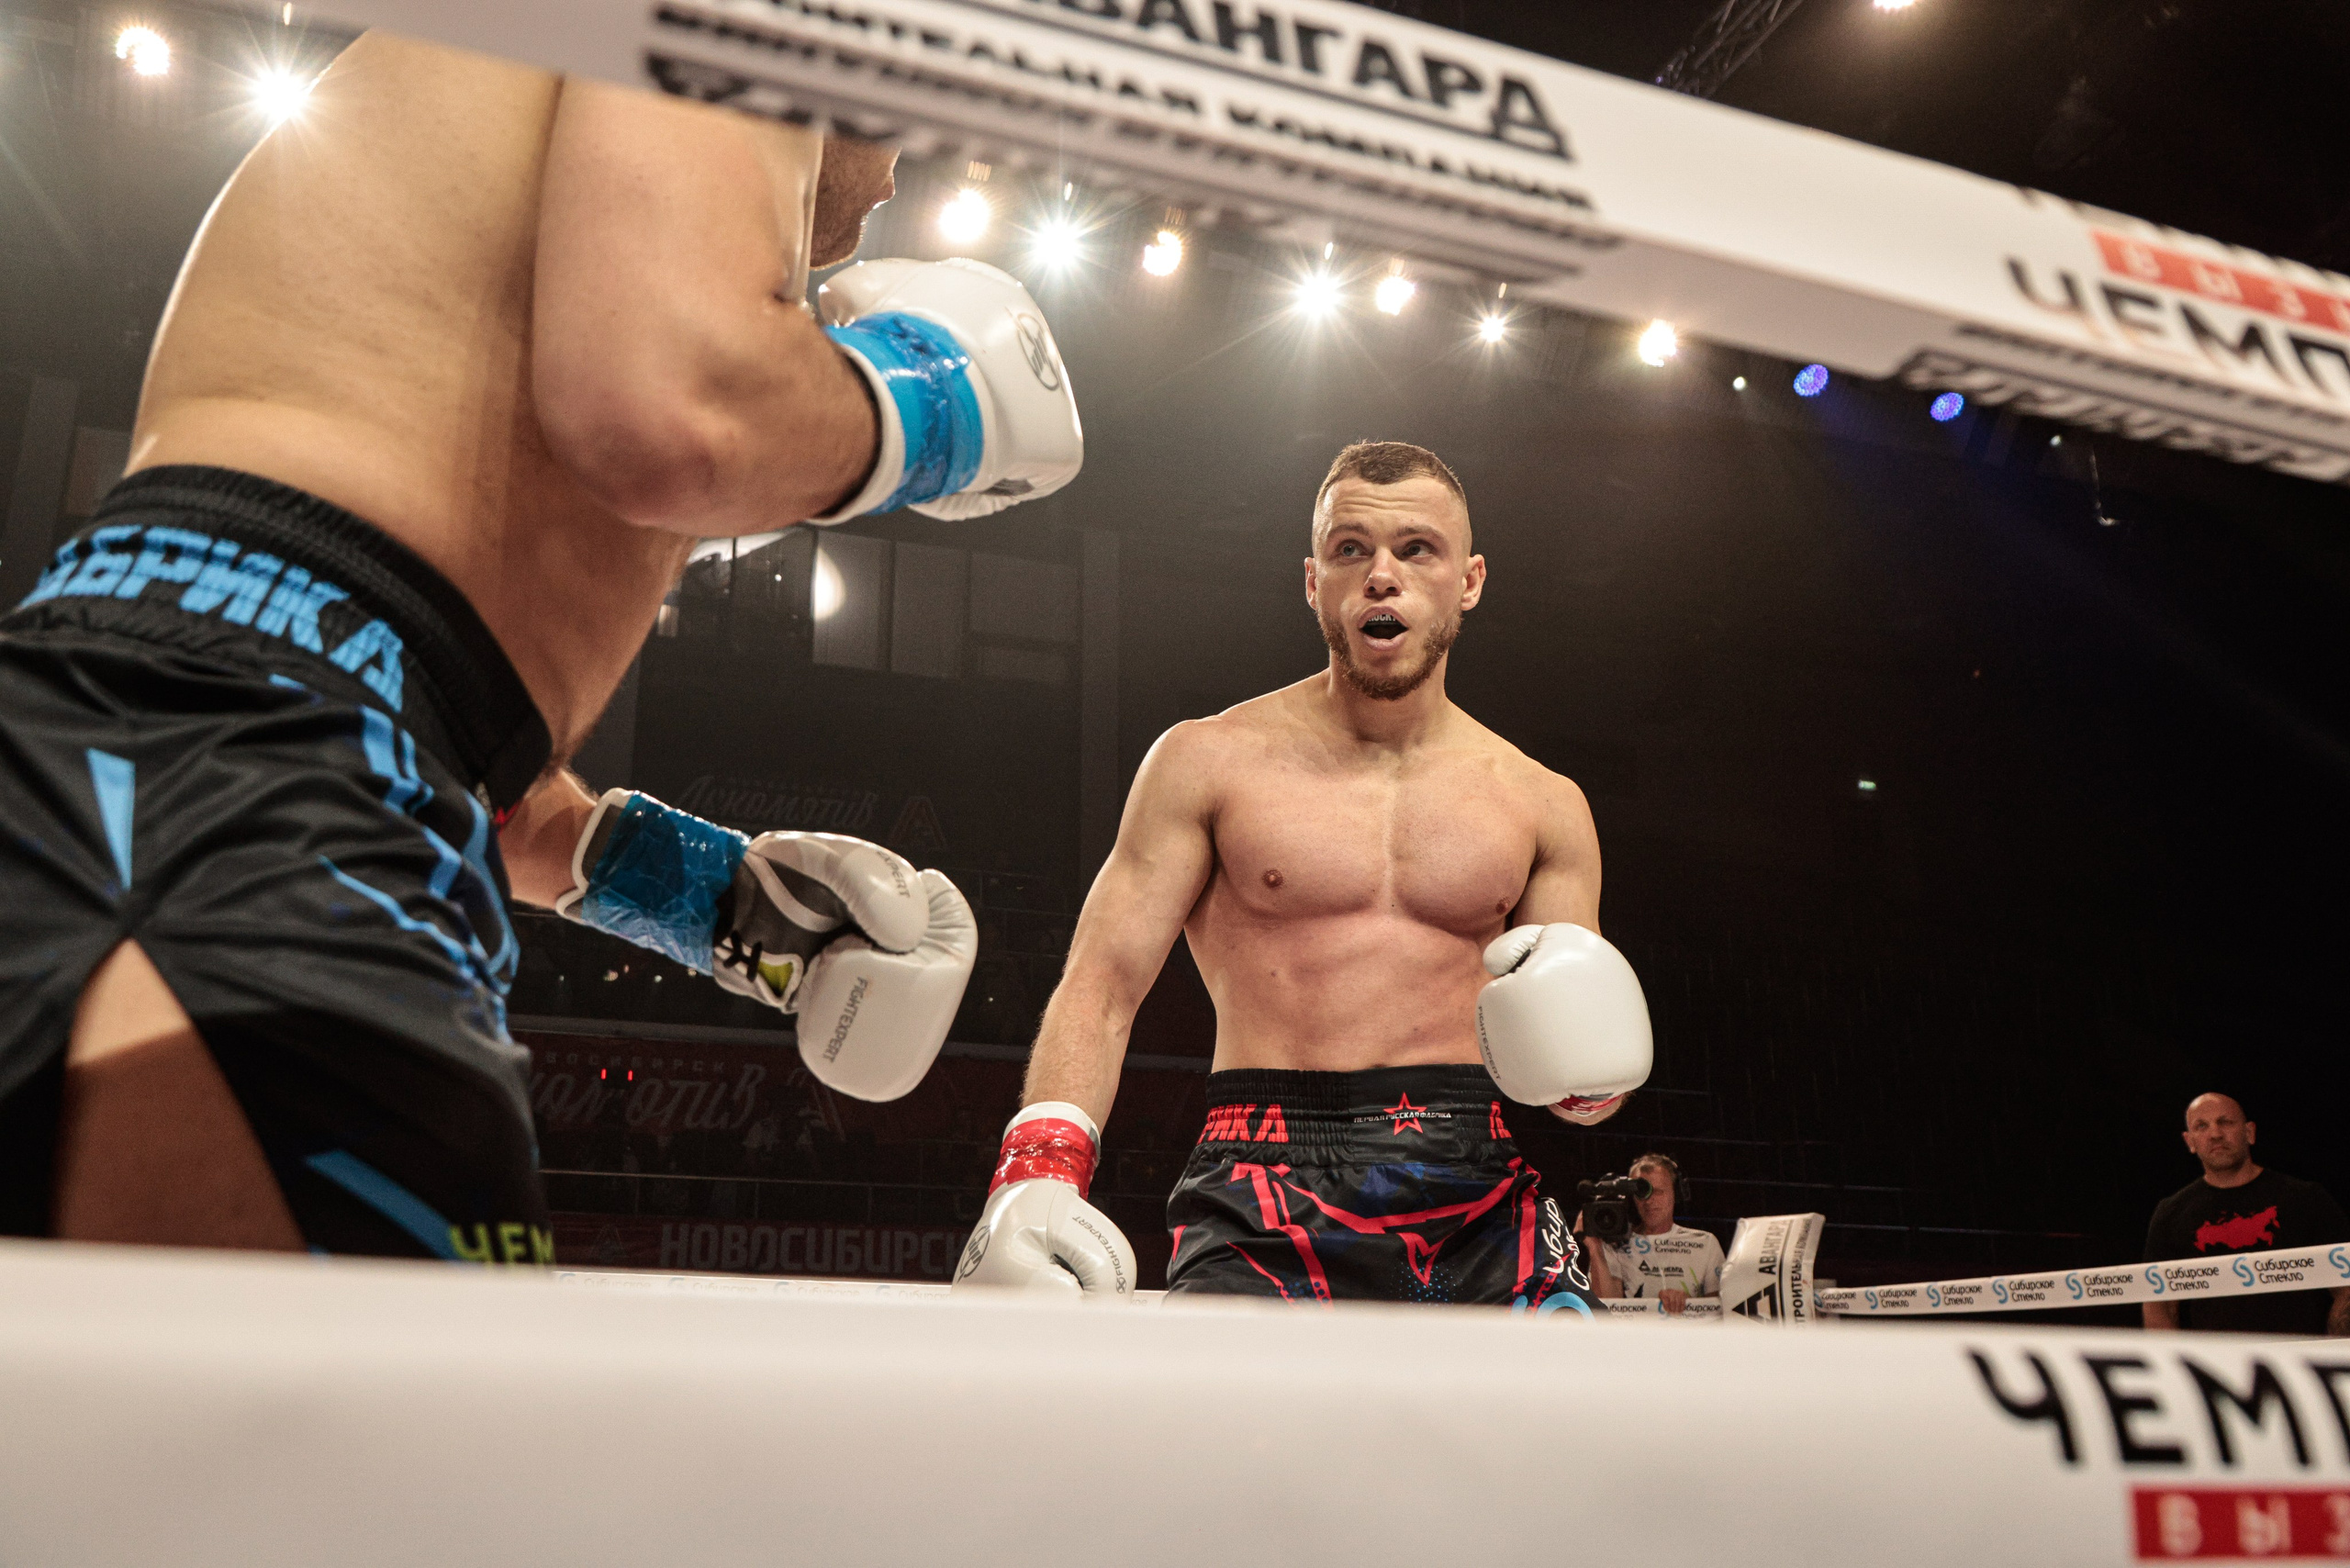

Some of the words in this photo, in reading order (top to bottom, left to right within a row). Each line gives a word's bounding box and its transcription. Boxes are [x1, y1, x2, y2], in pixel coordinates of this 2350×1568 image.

[822, 976, 868, 1063] FIGHTEXPERT
[1478, 1005, 1502, 1080] FIGHTEXPERT
[1072, 1215, 1124, 1276] FIGHTEXPERT
[2254, 1257, 2314, 1272] Сибирское
[2165, 1265, 2220, 1280] Сибирское
[2259, 1271, 2304, 1284] Стекло
[2084, 1273, 2133, 1285] Сибирское
[1942, 1284, 1983, 1295] Сибирское
[2009, 1280, 2055, 1292] Сибирское
[2087, 1286, 2124, 1297] Стекло
[2168, 1279, 2210, 1292] Стекло
[1878, 1288, 1918, 1299] Сибирское
[2011, 1291, 2046, 1302] Стекло
[1881, 1298, 1909, 1308] Стекло
[1943, 1295, 1975, 1306] Стекло
